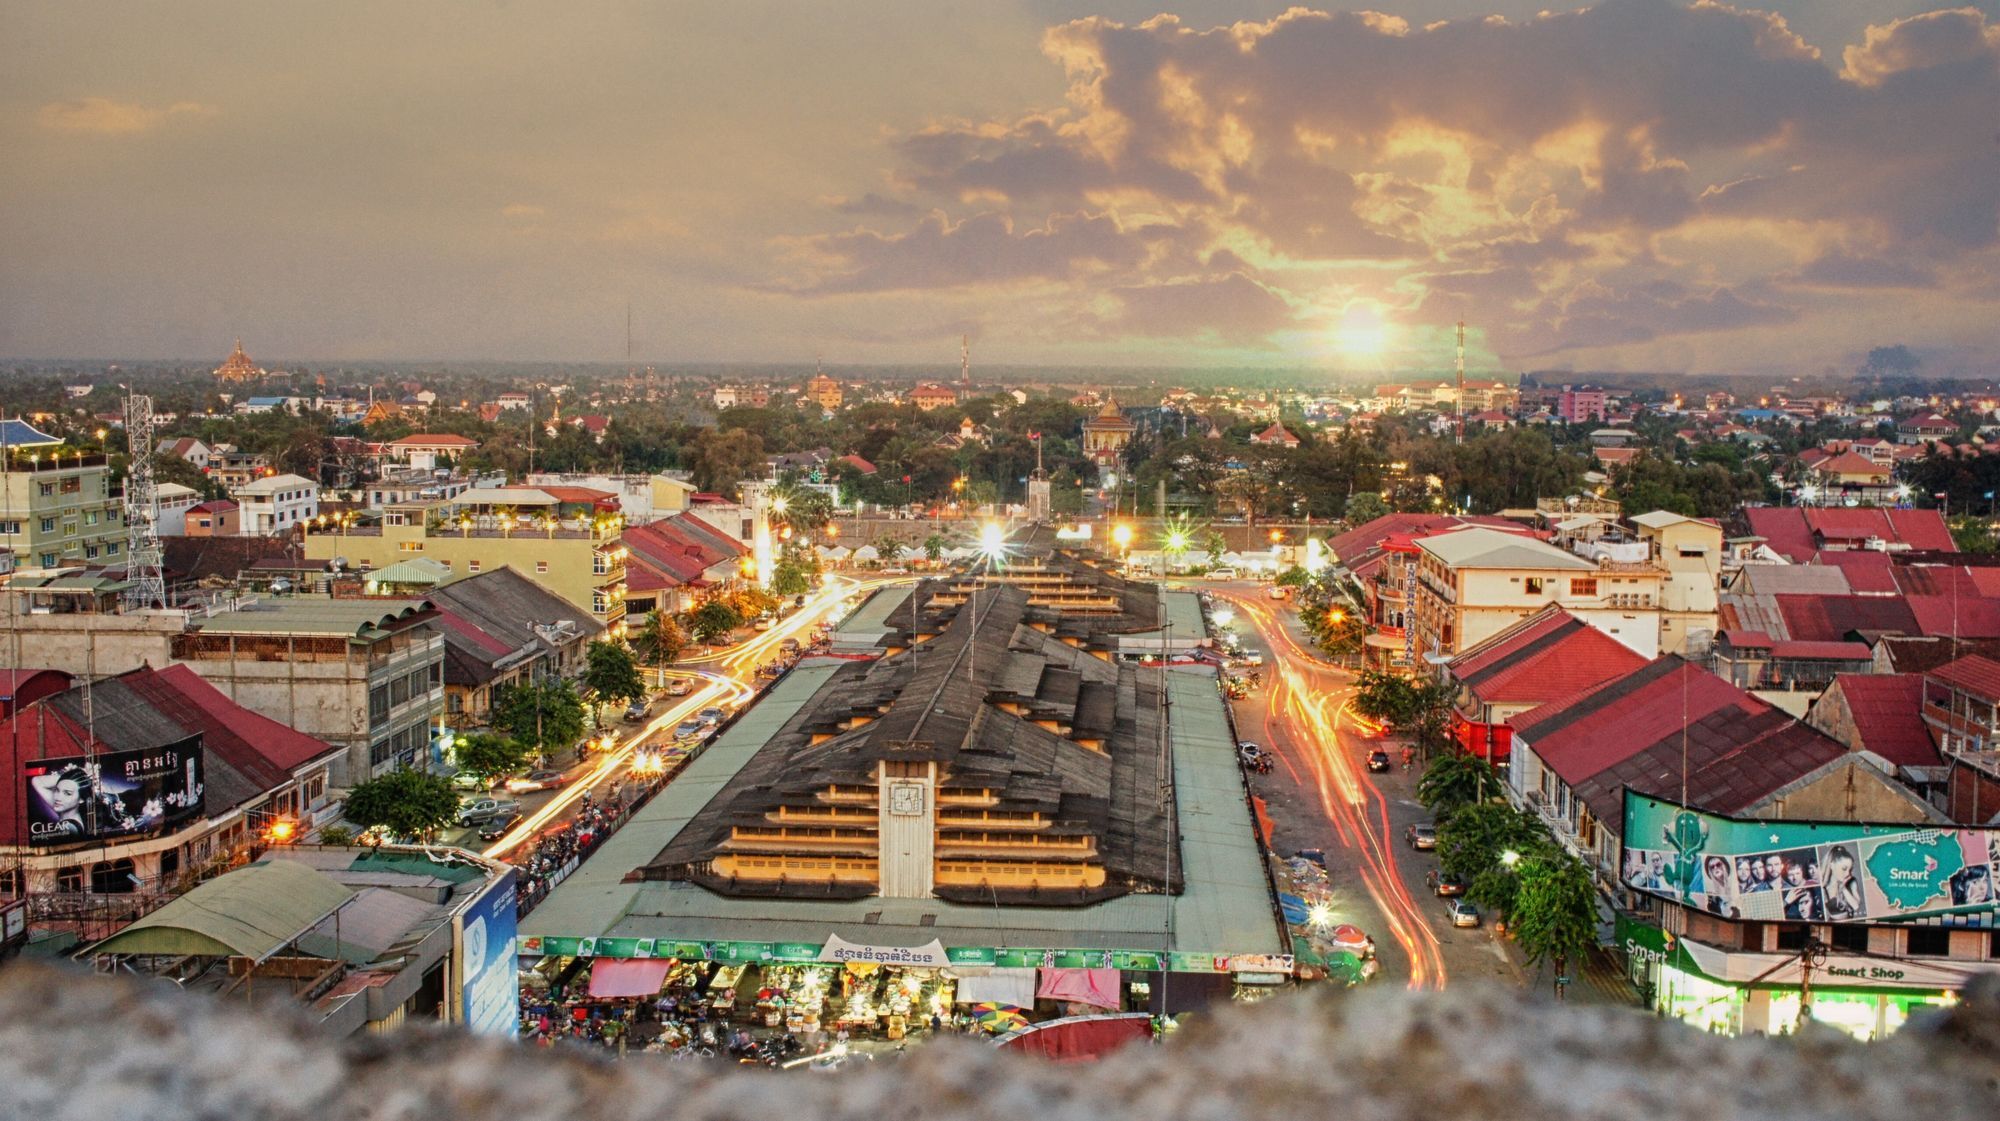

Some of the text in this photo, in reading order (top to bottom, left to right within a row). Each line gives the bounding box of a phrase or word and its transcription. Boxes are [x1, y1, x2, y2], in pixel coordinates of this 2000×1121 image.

[1406, 564, 1415, 659] INTERNATIONAL
[31, 821, 70, 834] CLEAR
[1890, 868, 1929, 880] Smart
[1626, 939, 1667, 965] Smart
[1827, 965, 1904, 980] Smart Shop
